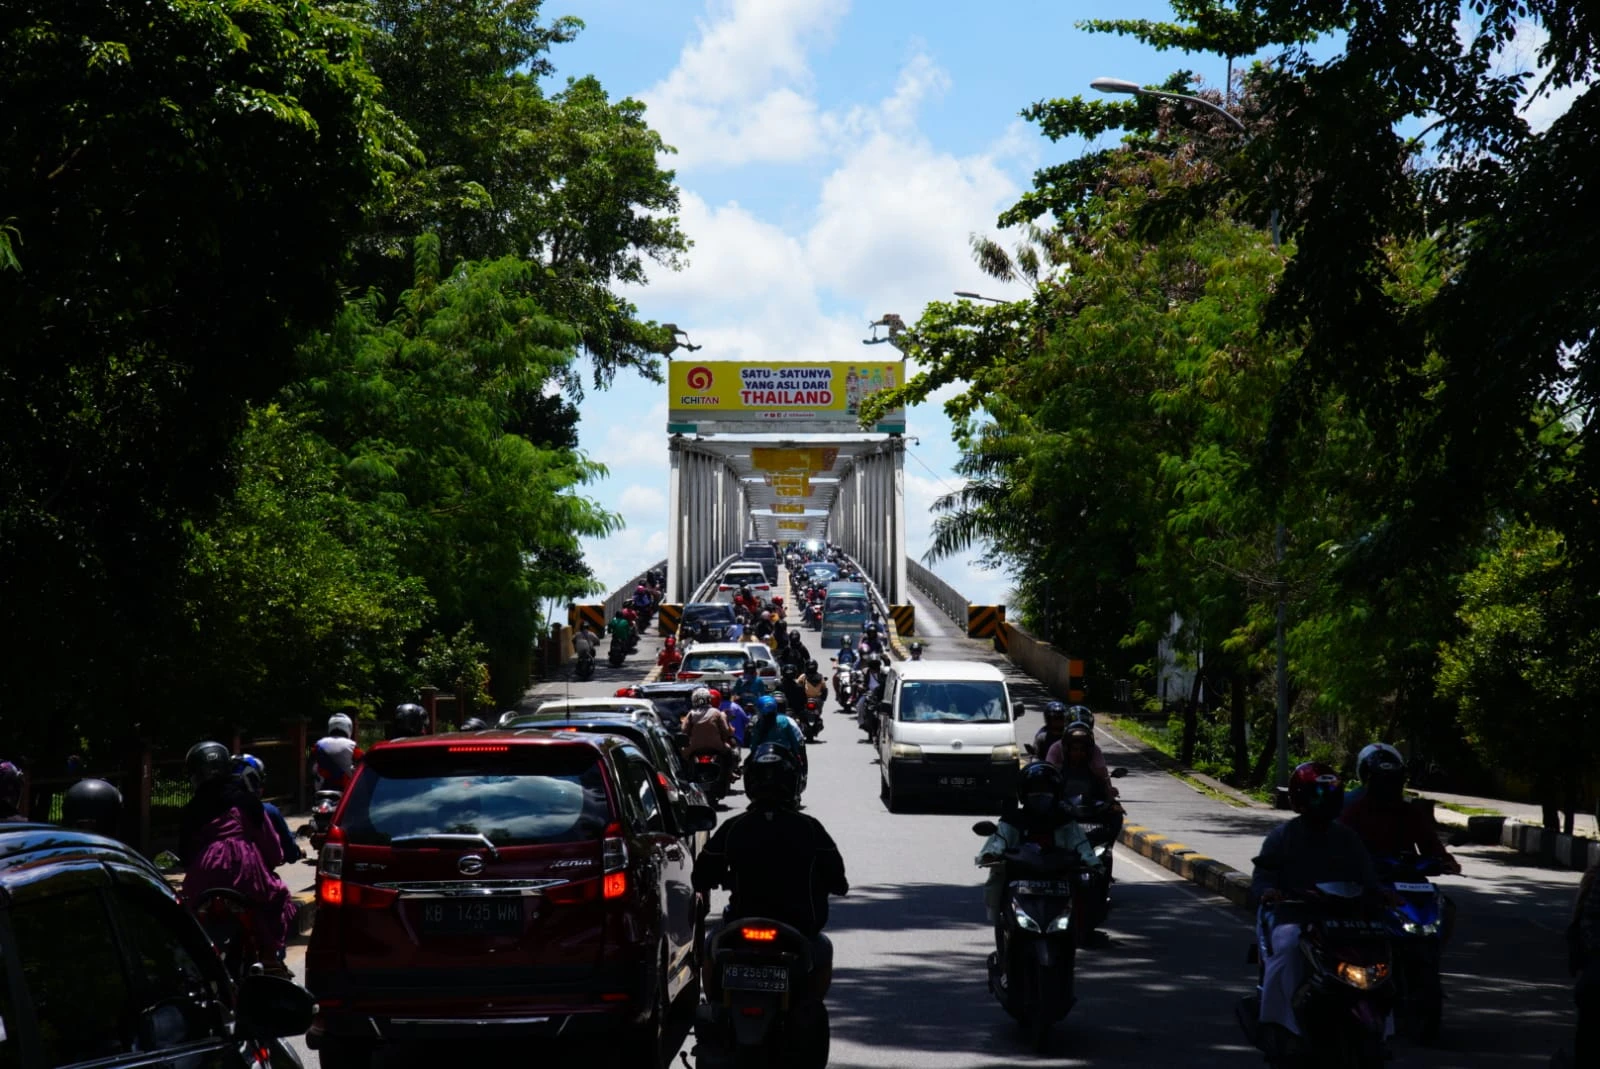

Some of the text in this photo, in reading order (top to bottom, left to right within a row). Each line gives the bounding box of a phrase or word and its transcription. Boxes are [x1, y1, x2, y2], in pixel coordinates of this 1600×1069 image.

[742, 369, 770, 378] SATU
[780, 369, 831, 378] SATUNYA
[745, 381, 828, 390] YANG ASLI DARI
[681, 396, 719, 405] ICHITAN
[741, 391, 832, 404] THAILAND
